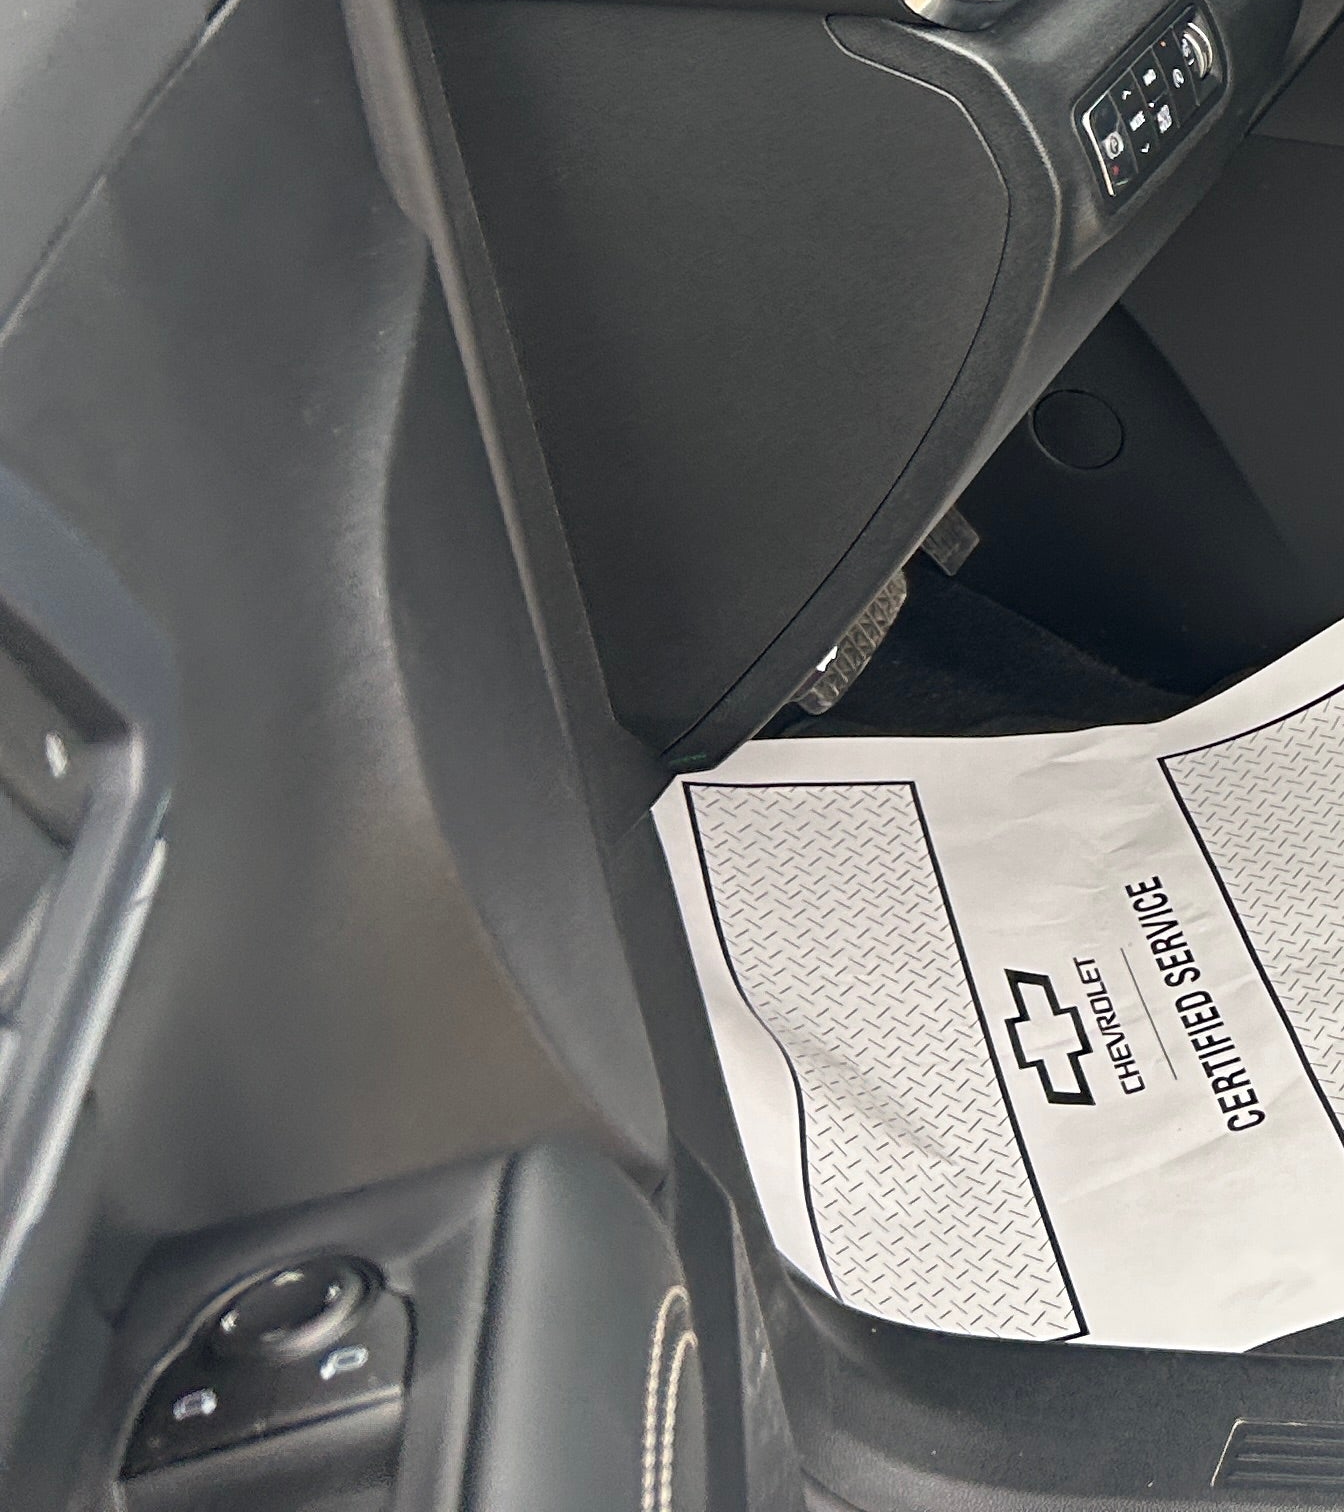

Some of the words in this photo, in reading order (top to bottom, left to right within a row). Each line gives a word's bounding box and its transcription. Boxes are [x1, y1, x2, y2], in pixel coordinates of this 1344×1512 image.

[1124, 875, 1202, 988] SERVICE
[1072, 956, 1147, 1095] CHEVROLET
[1174, 990, 1267, 1132] CERTIFIED
